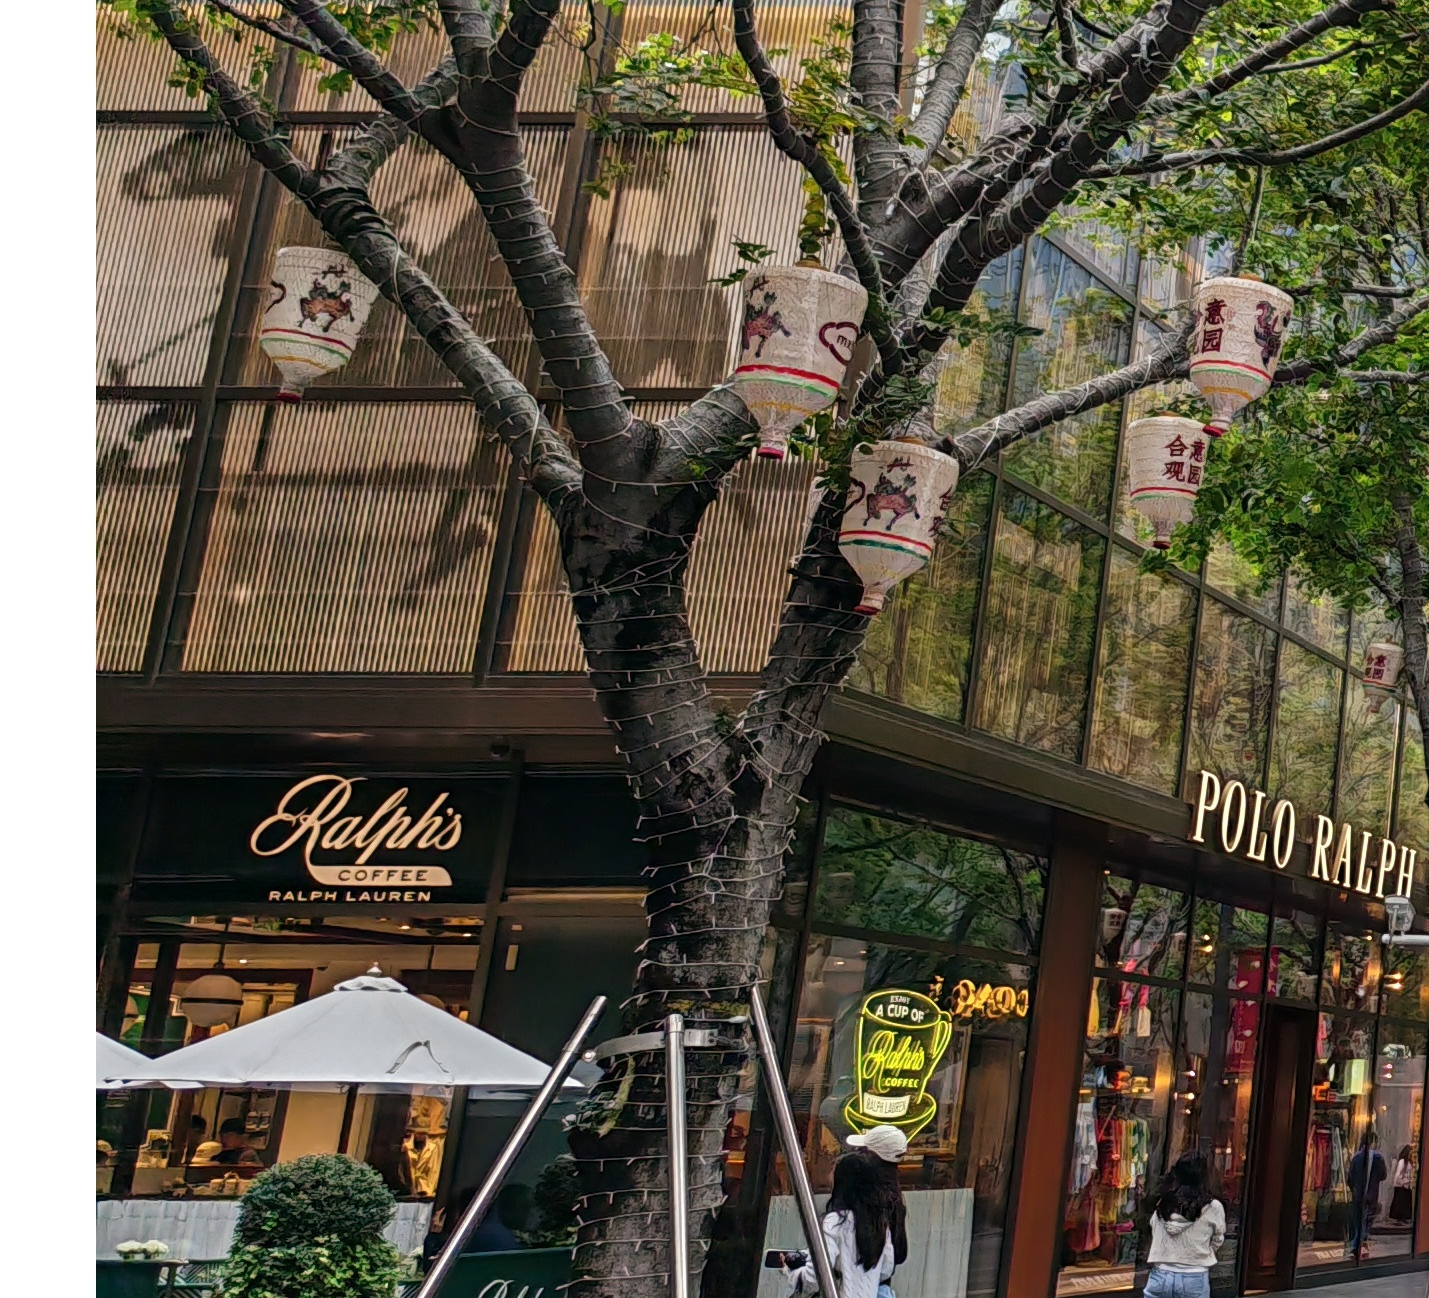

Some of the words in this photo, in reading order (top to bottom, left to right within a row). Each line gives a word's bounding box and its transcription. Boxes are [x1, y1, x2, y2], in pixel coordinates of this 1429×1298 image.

[251, 774, 462, 865] Ralph's
[1192, 770, 1296, 869] POLO
[1311, 814, 1417, 899] RALPH
[338, 870, 429, 882] COFFEE
[269, 891, 338, 902] RALPH
[346, 891, 431, 902] LAUREN
[876, 1004, 884, 1017] A
[887, 1004, 909, 1018] CUP
[911, 1008, 925, 1023] OF
[863, 1030, 925, 1081] Ralph's
[884, 1078, 919, 1088] COFFEE
